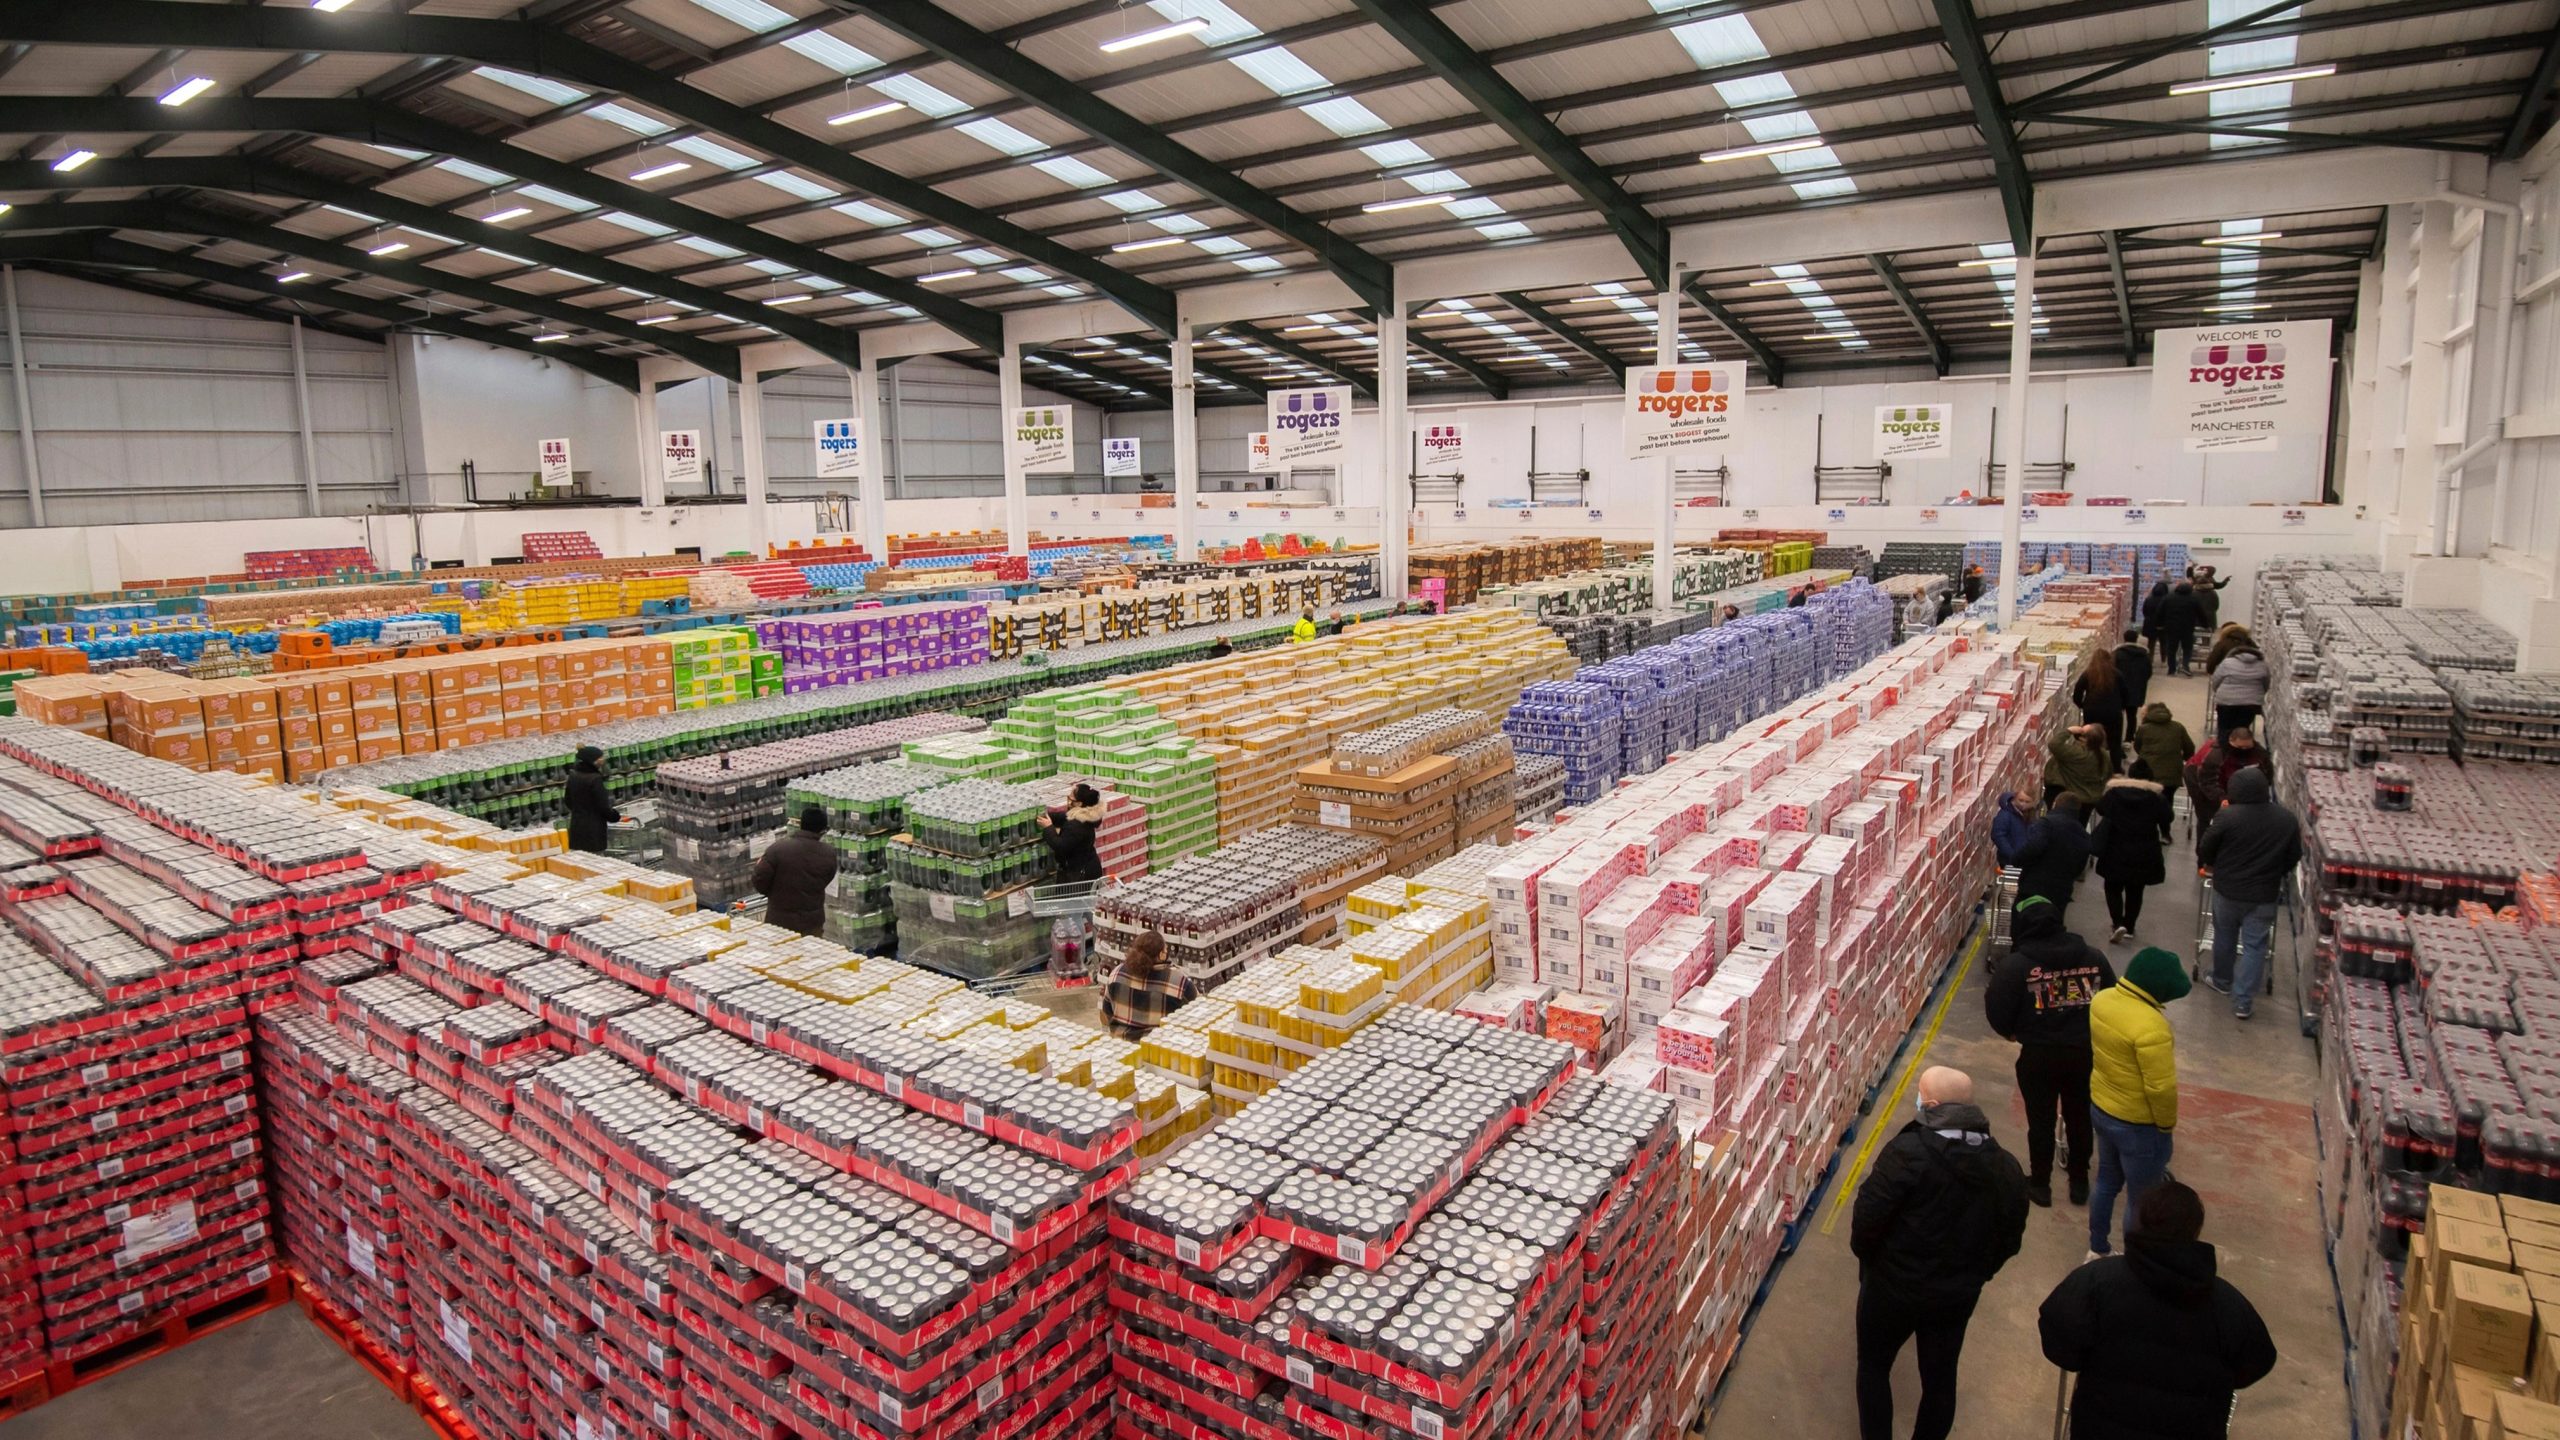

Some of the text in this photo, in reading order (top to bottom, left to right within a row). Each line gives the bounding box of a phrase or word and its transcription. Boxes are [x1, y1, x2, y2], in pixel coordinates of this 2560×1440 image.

[2196, 329, 2282, 342] WELCOME TO
[2190, 365, 2285, 387] rogers
[1638, 395, 1728, 418] rogers
[1277, 412, 1340, 433] rogers
[1670, 415, 1727, 427] wholesale foods
[2191, 421, 2275, 431] MANCHESTER
[1017, 427, 1064, 445] rogers
[1675, 430, 1702, 438] BIGGEST
[1882, 422, 1940, 436] rogers
[1425, 437, 1461, 449] rogers
[1692, 433, 1730, 443] warehouse!
[820, 438, 857, 453] rogers
[1253, 445, 1269, 455] rog
[543, 454, 566, 466] rogers
[666, 447, 695, 461] rogers
[1107, 450, 1135, 460] rogers
[1558, 1023, 1571, 1031] you
[1670, 1040, 1700, 1053] be kind
[1142, 1240, 1173, 1257] KINGSLEY
[1298, 1239, 1333, 1254] KINGSLEY
[1310, 1347, 1346, 1363] KINGSLEY
[1249, 1356, 1283, 1375] KINGSLEY
[1198, 1371, 1232, 1388] KINGSLEY
[1392, 1377, 1432, 1395] KINGSLEY
[1370, 1405, 1409, 1427] KINGSLEY
[1304, 1419, 1340, 1437] KINGSLEY
